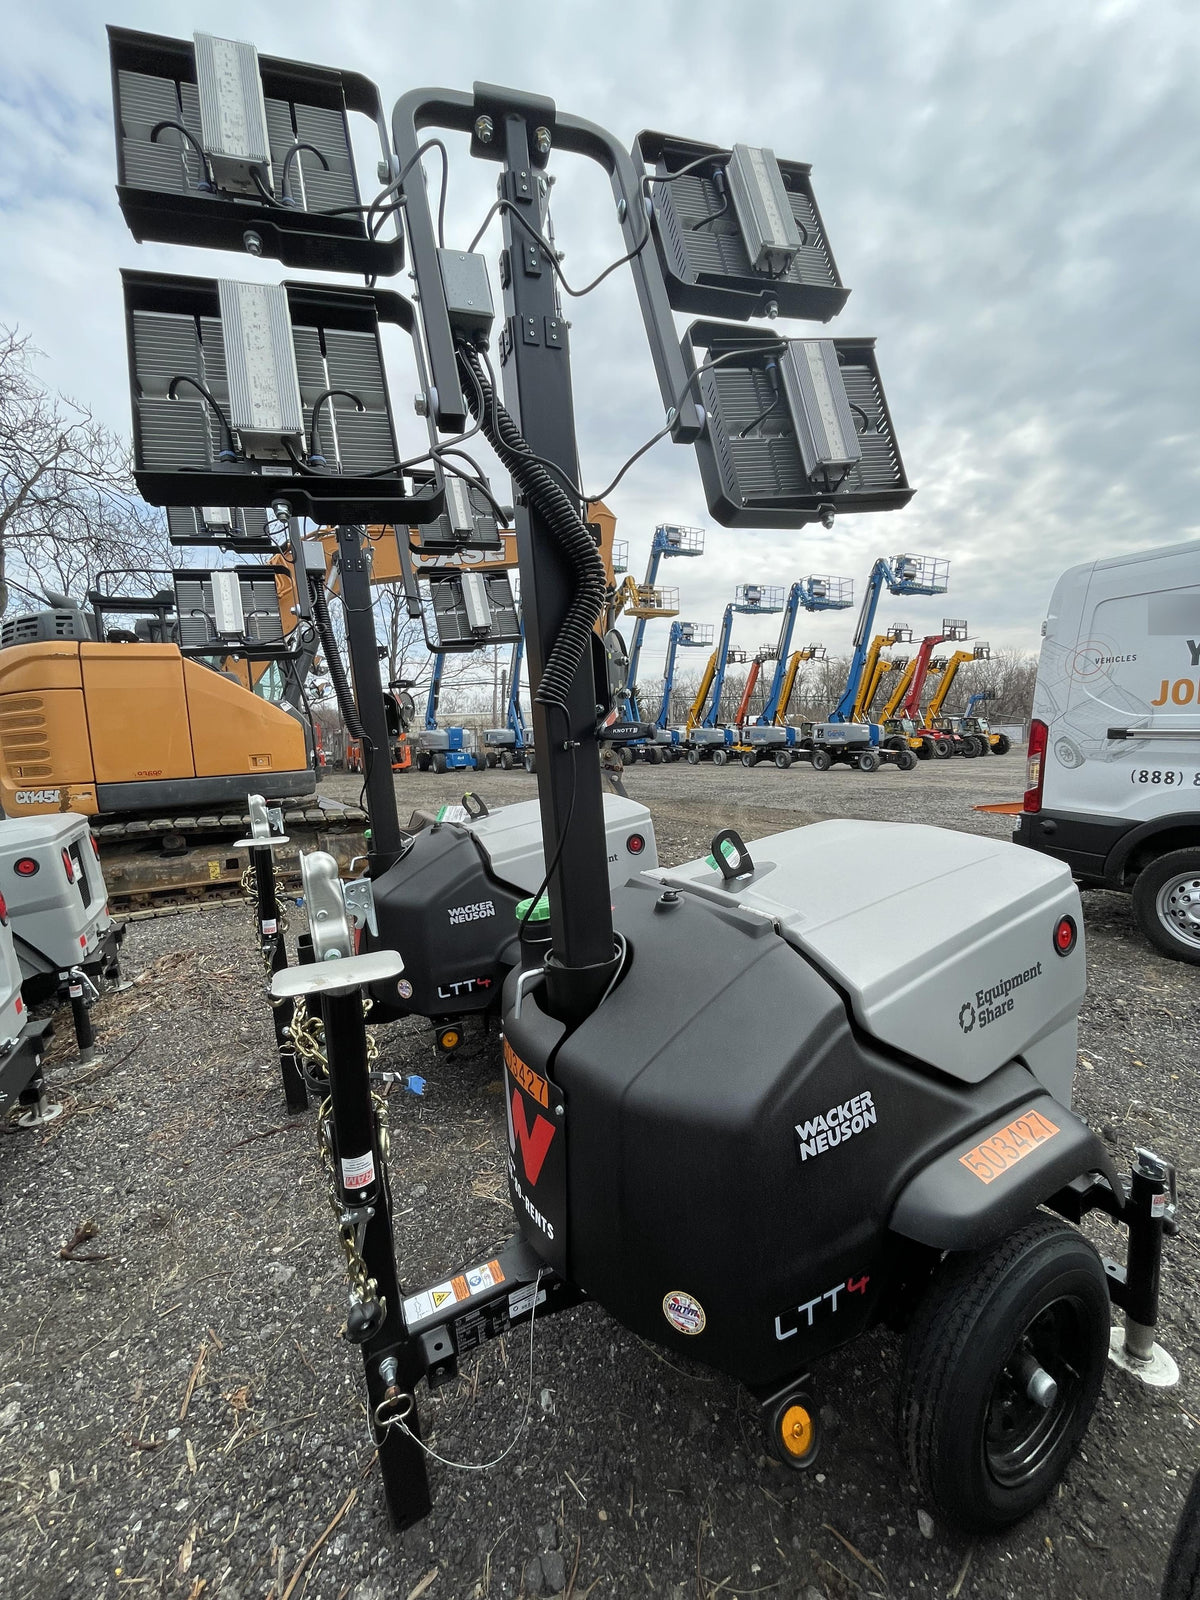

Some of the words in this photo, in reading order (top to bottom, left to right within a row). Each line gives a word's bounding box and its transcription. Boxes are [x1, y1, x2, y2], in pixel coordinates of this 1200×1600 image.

[1095, 654, 1137, 665] VEHICLES
[1151, 678, 1200, 707] JO
[1131, 769, 1184, 786] (888)
[447, 900, 494, 917] WACKER
[449, 908, 496, 925] NEUSON
[975, 961, 1042, 1009] Equipment
[978, 998, 1015, 1029] Share
[503, 1040, 546, 1102] 03427
[794, 1090, 875, 1141] WACKER
[799, 1106, 878, 1161] NEUSON
[964, 1112, 1054, 1179] 503427
